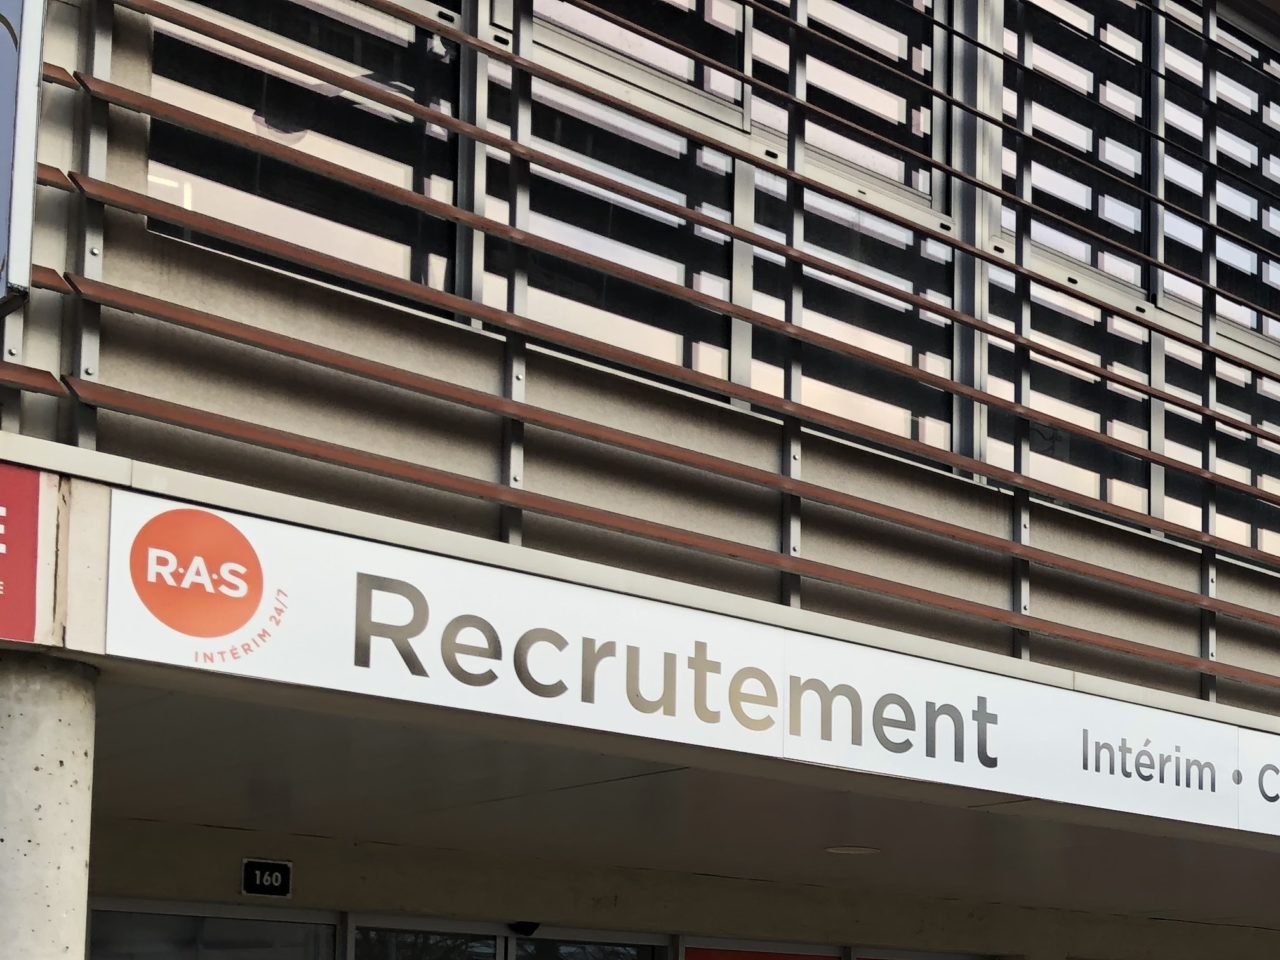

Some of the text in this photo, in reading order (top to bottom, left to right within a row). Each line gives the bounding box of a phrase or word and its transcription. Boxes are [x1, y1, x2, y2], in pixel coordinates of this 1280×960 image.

[194, 588, 289, 664] INTÉRIM 24/7
[353, 571, 998, 769] Recrutement
[1081, 728, 1217, 793] Intérim
[254, 870, 282, 887] 160
